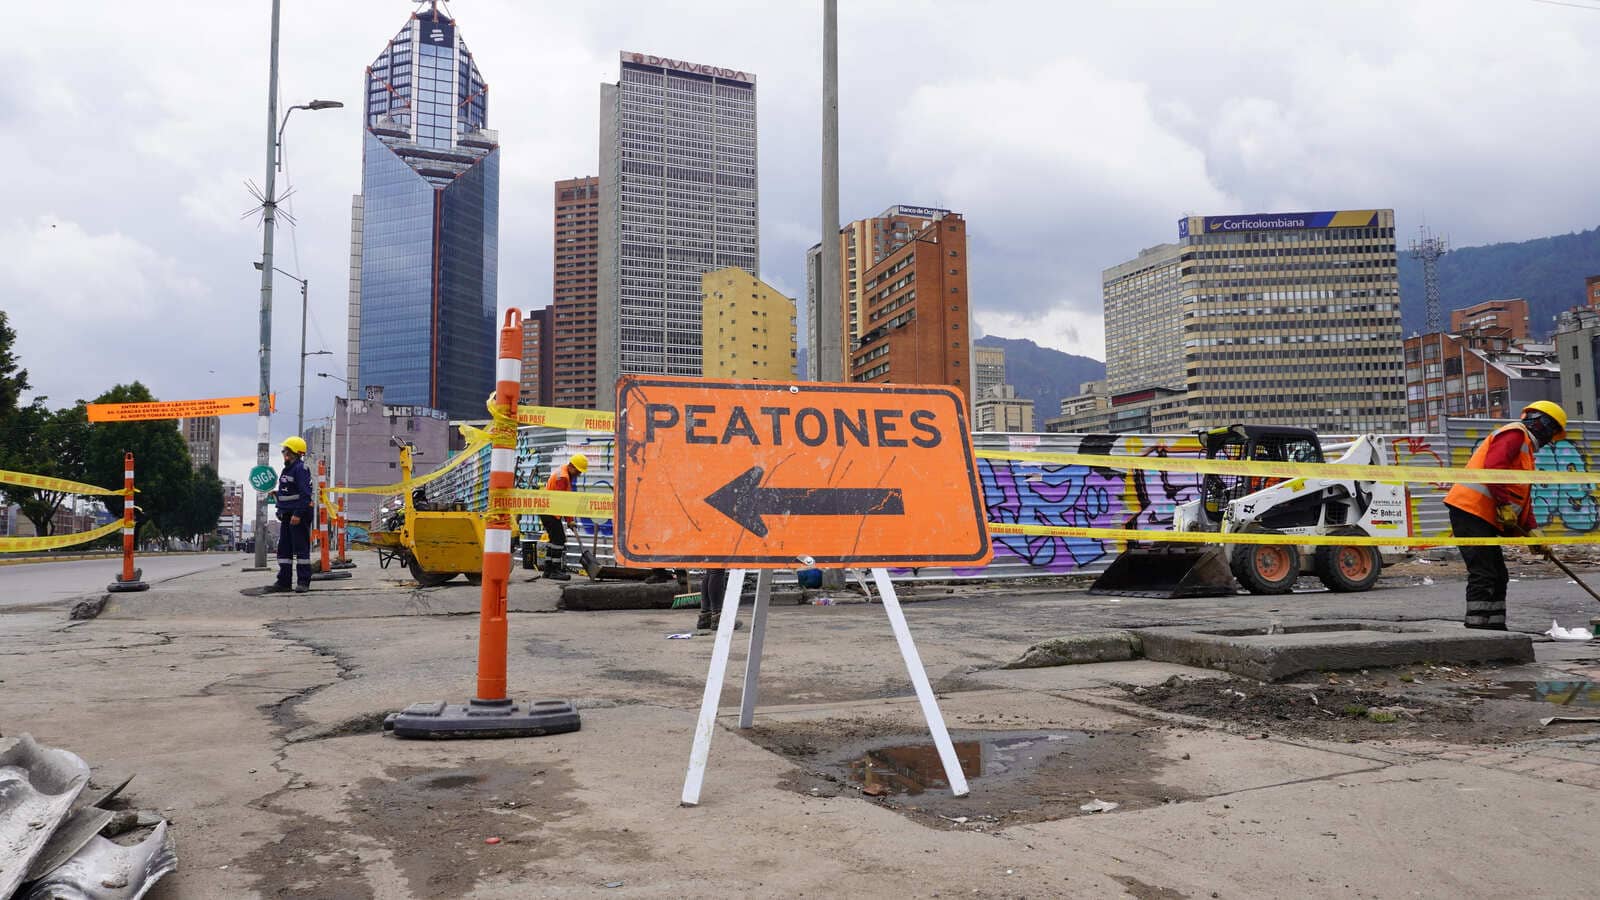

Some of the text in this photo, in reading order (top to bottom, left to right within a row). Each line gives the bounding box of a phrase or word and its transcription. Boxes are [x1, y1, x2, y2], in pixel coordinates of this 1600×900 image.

[648, 55, 748, 81] DAVIVIENDA
[900, 206, 916, 214] Banco
[1223, 218, 1305, 230] Corficolombiana
[518, 414, 546, 425] NO PASE
[584, 418, 611, 431] PELIGRO
[645, 403, 942, 448] PEATONES
[252, 470, 275, 487] SIGA
[493, 496, 551, 509] PELIGRO NO PASE
[1380, 509, 1402, 517] Bobcat
